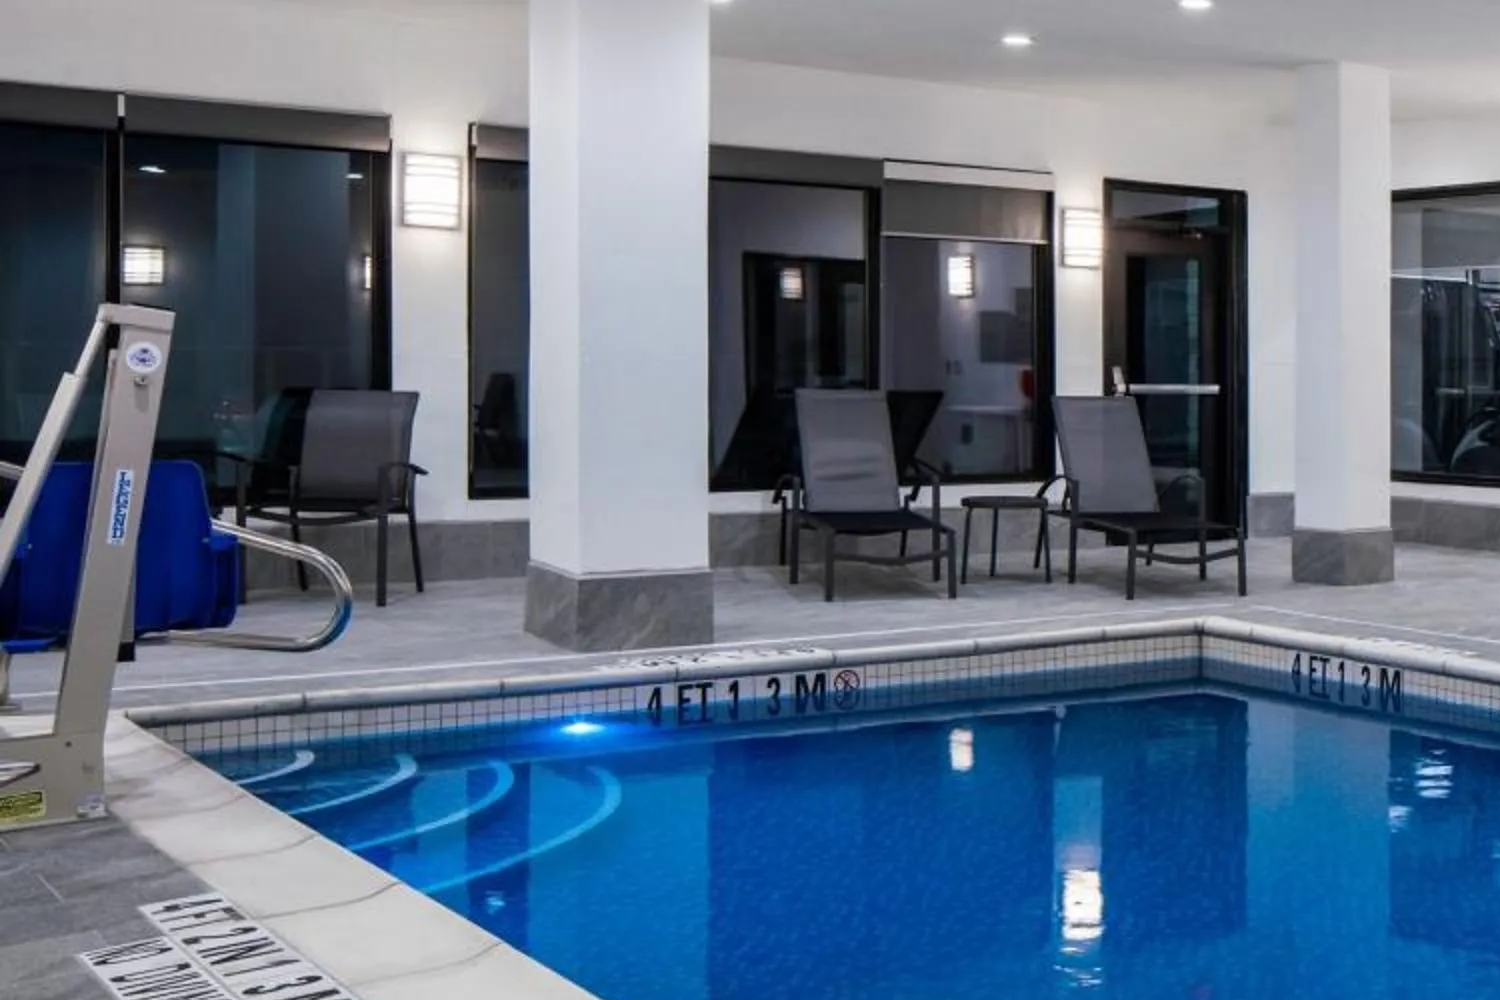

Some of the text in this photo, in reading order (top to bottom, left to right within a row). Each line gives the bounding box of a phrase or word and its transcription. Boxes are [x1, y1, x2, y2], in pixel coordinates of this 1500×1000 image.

[1309, 656, 1330, 678] FT
[1380, 668, 1401, 692] M
[678, 682, 713, 706] FT
[795, 672, 826, 697] M
[182, 926, 258, 946] 2
[196, 937, 285, 966] IN
[222, 959, 301, 977] 1
[242, 975, 323, 996] 3
